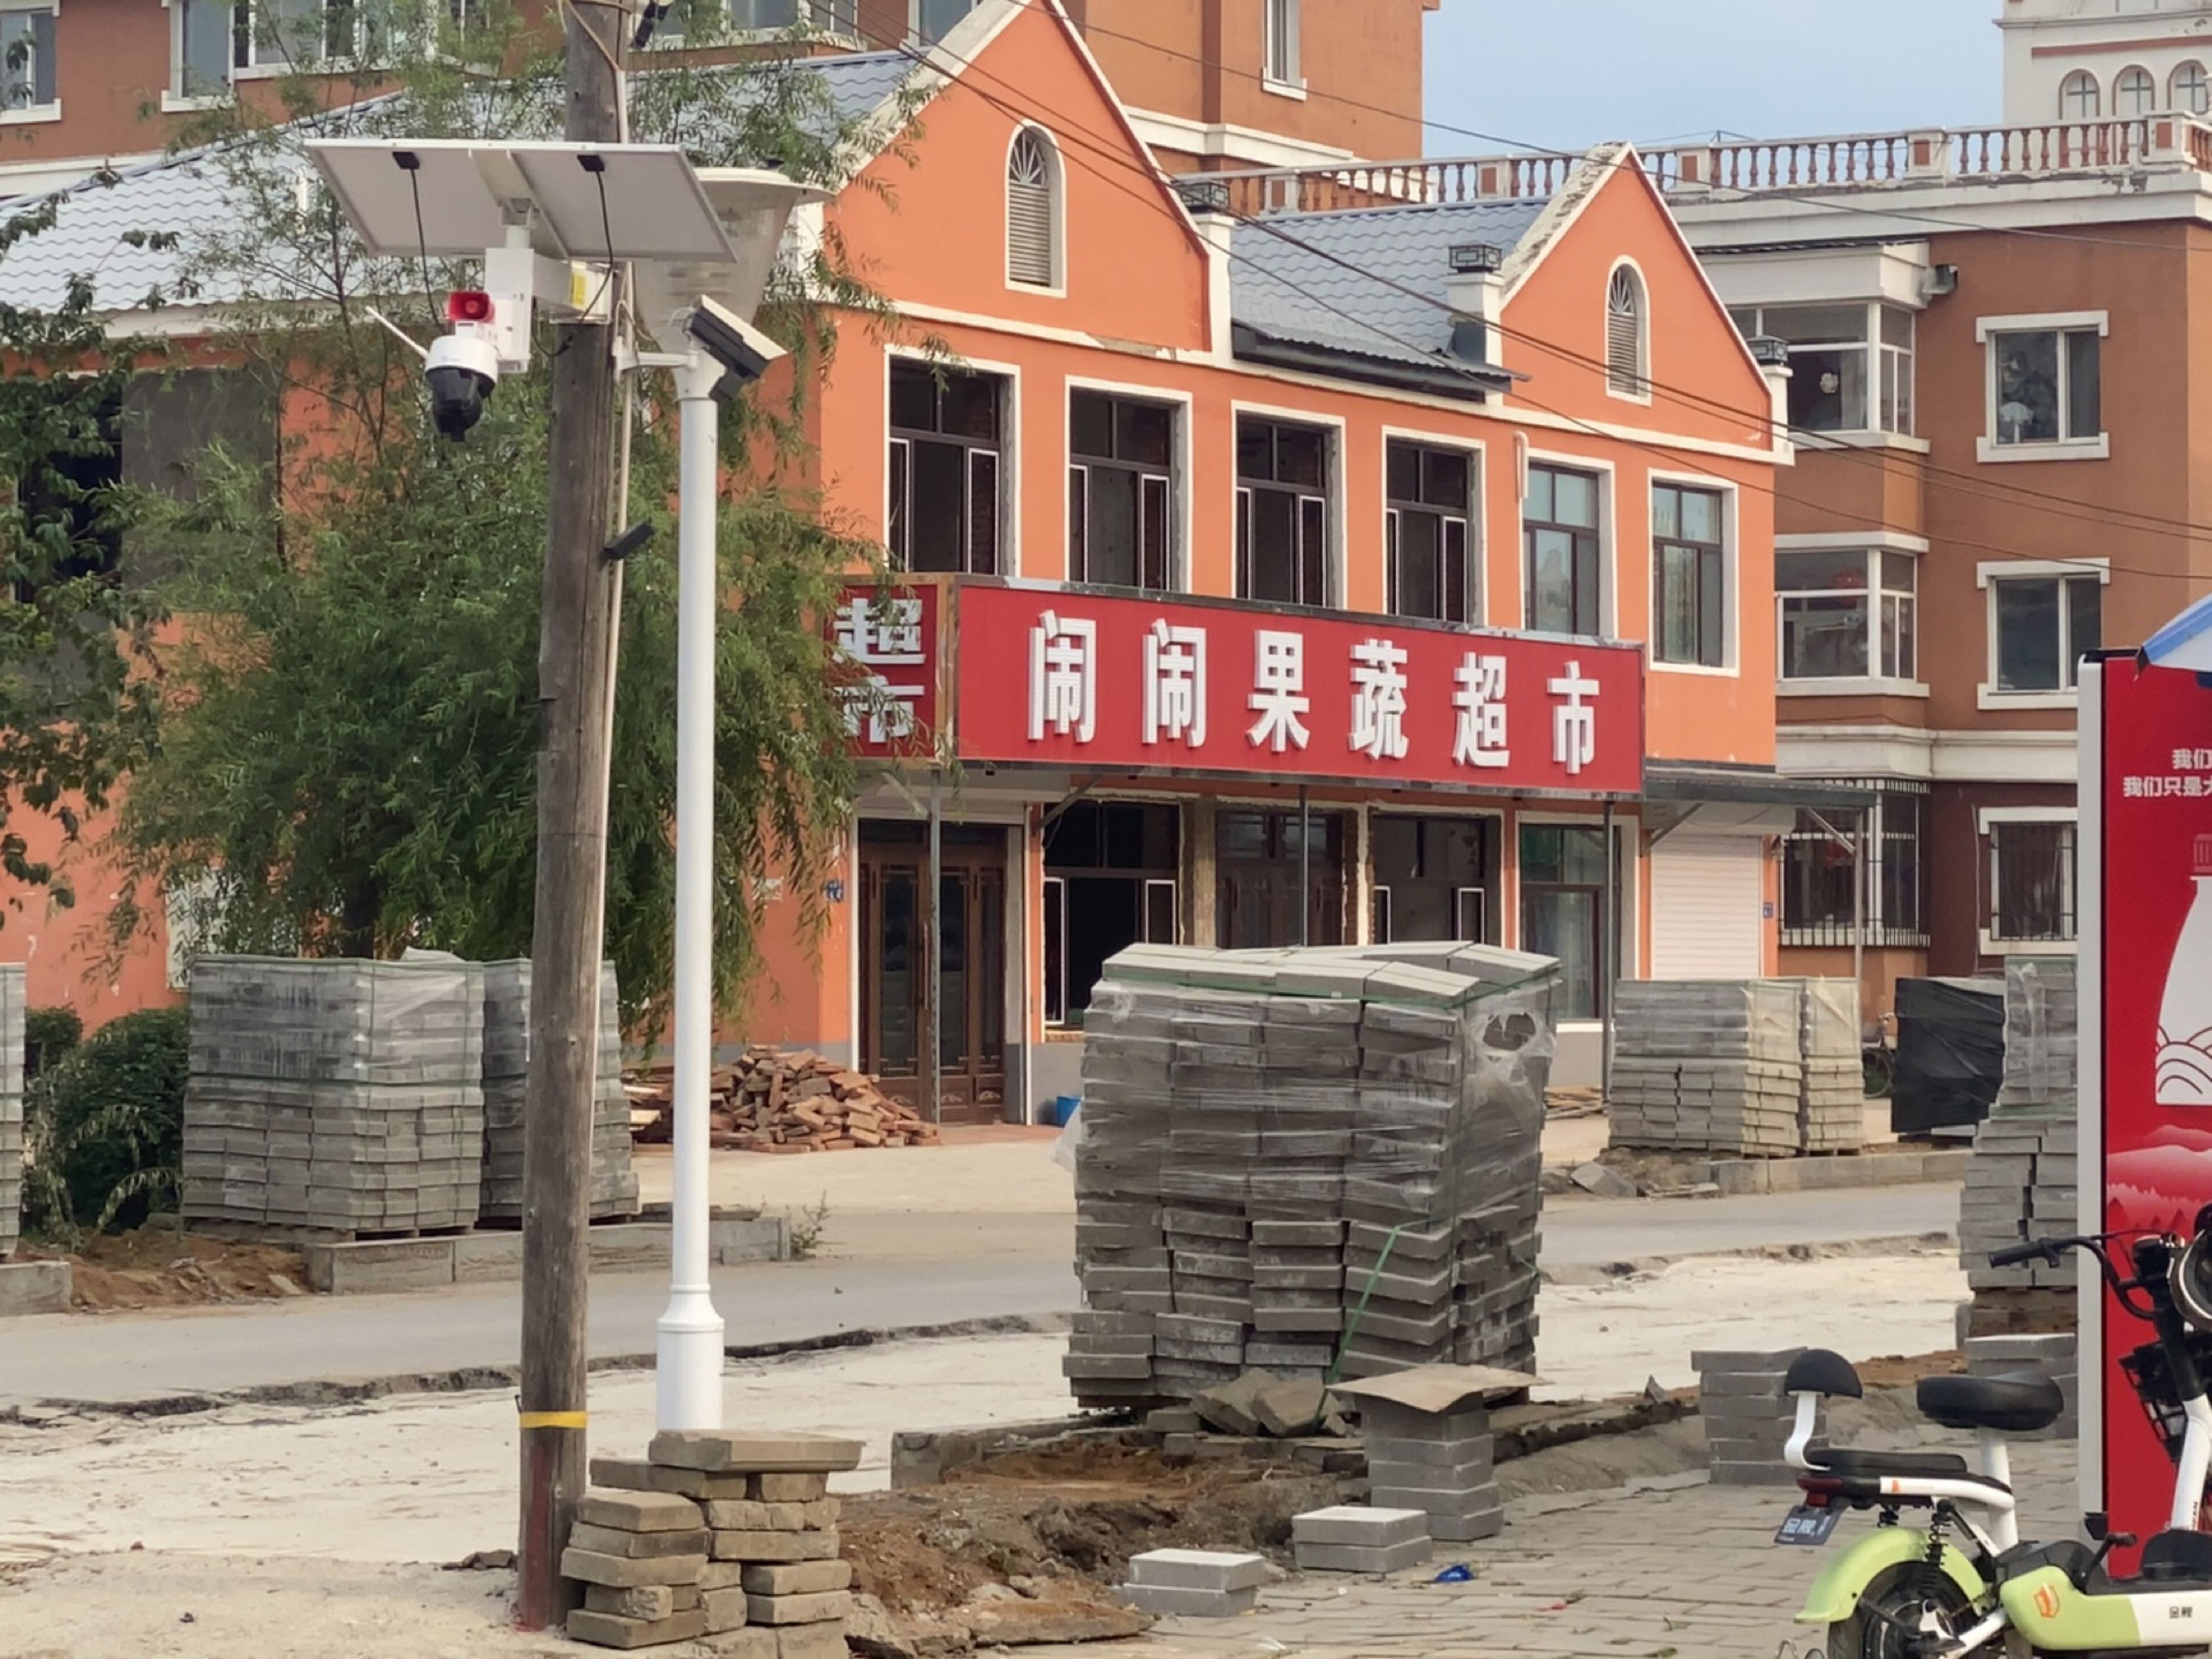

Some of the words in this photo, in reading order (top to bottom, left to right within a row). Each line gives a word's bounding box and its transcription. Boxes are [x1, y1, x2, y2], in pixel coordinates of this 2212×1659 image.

[833, 598, 926, 742] 超市
[1029, 609, 1600, 774] 闹闹果蔬超市
